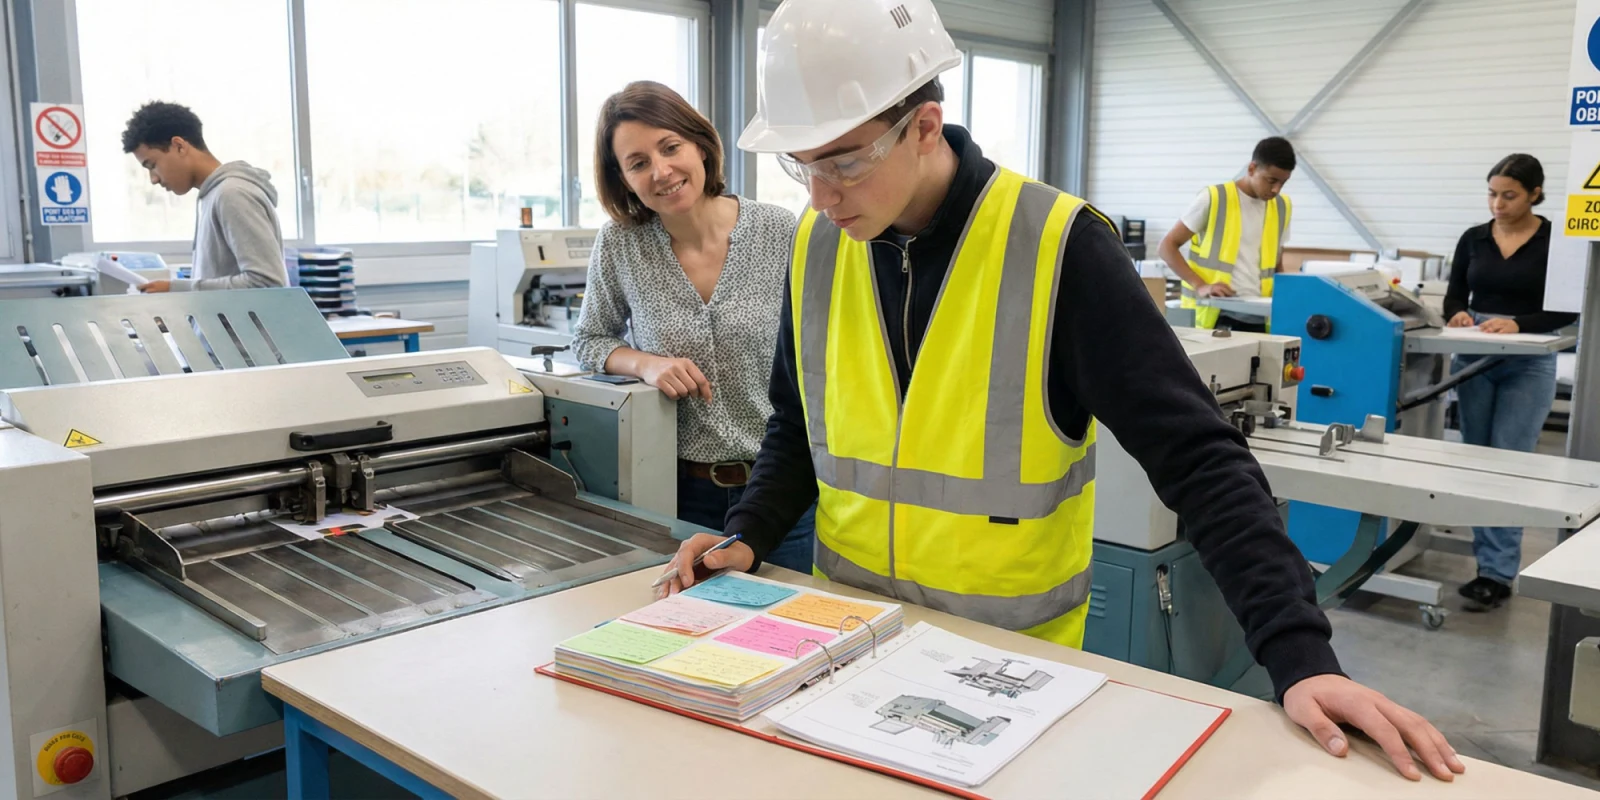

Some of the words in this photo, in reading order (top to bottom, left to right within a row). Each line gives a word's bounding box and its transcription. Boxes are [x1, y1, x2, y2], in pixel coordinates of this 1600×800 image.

[1576, 90, 1600, 104] PO
[1576, 107, 1600, 122] OB
[1585, 201, 1600, 213] ZO
[1568, 218, 1599, 230] CIRC
